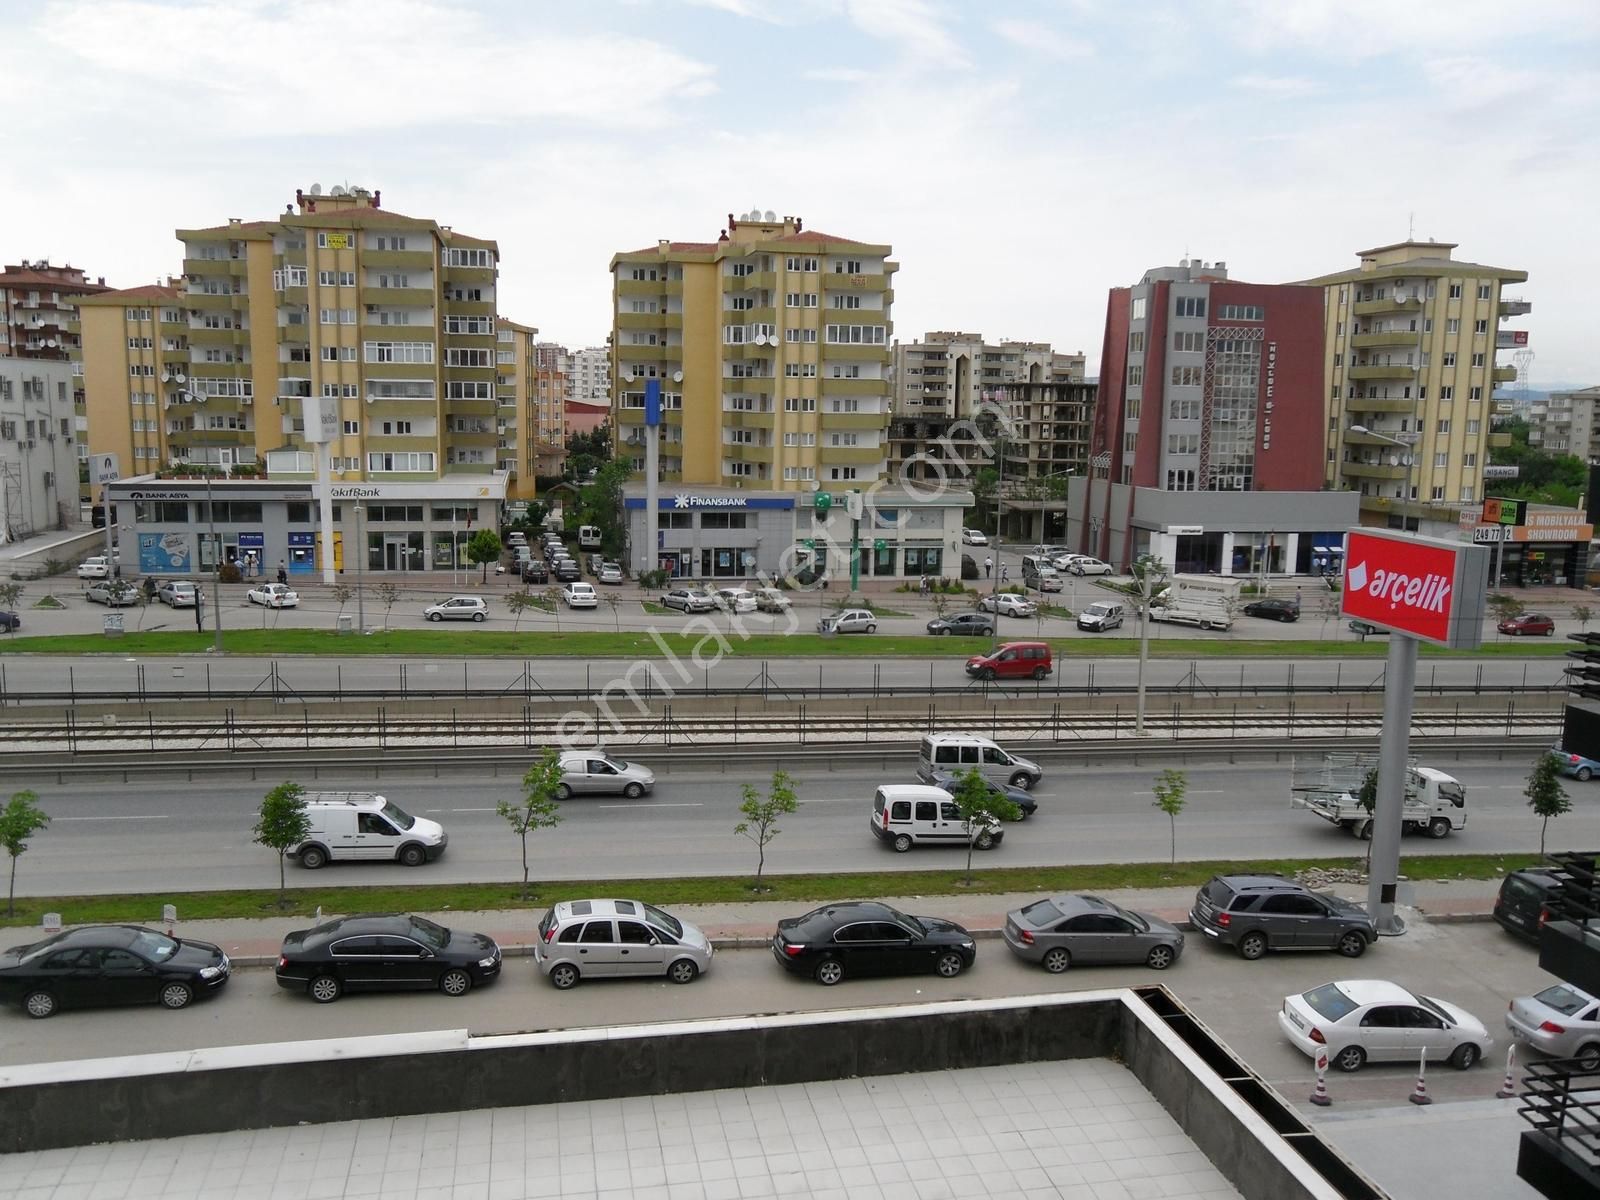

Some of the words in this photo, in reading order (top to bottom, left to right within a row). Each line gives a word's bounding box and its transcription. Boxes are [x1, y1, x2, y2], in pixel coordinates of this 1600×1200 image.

[1267, 342, 1277, 397] merkezi
[1475, 528, 1489, 540] 249
[1527, 528, 1578, 539] SHOWROOM
[1368, 569, 1451, 613] arçelik
